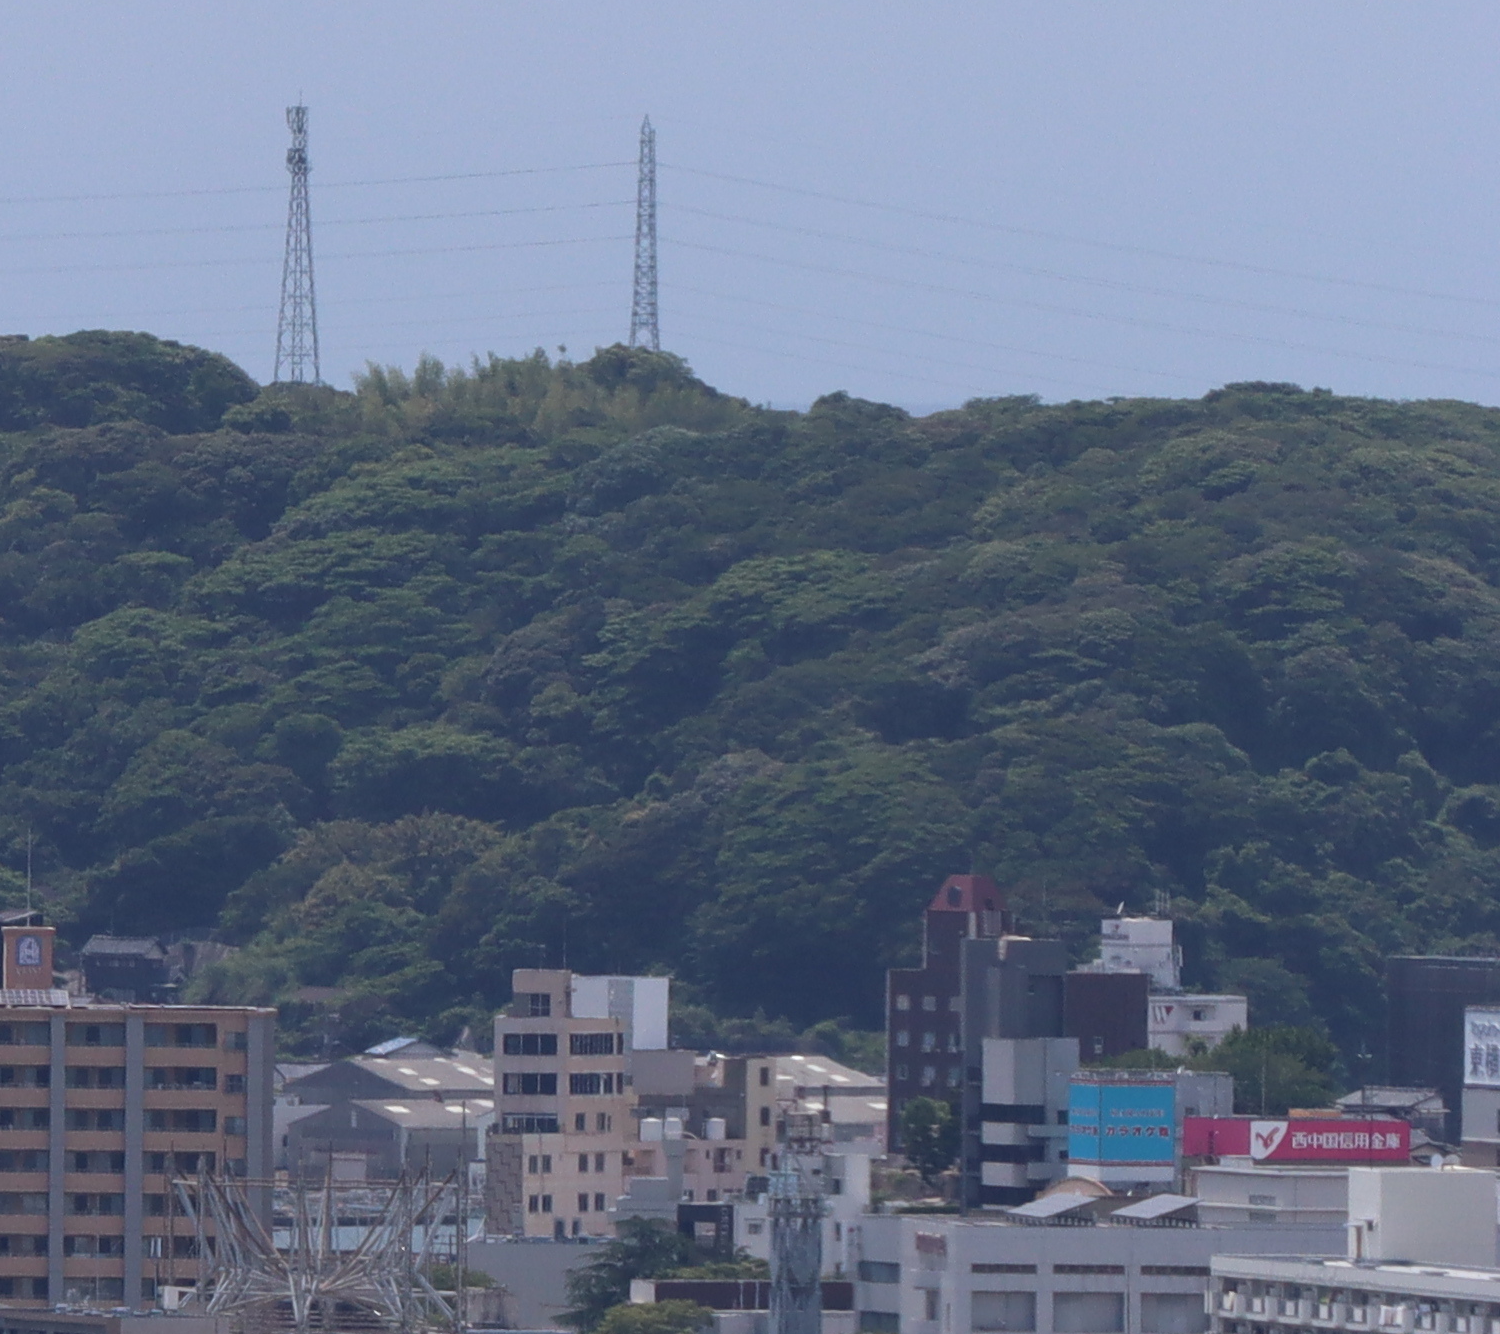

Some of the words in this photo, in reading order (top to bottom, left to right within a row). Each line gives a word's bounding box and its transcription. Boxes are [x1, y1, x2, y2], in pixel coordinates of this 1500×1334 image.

[1291, 1131, 1401, 1150] 西中国信用金庫
